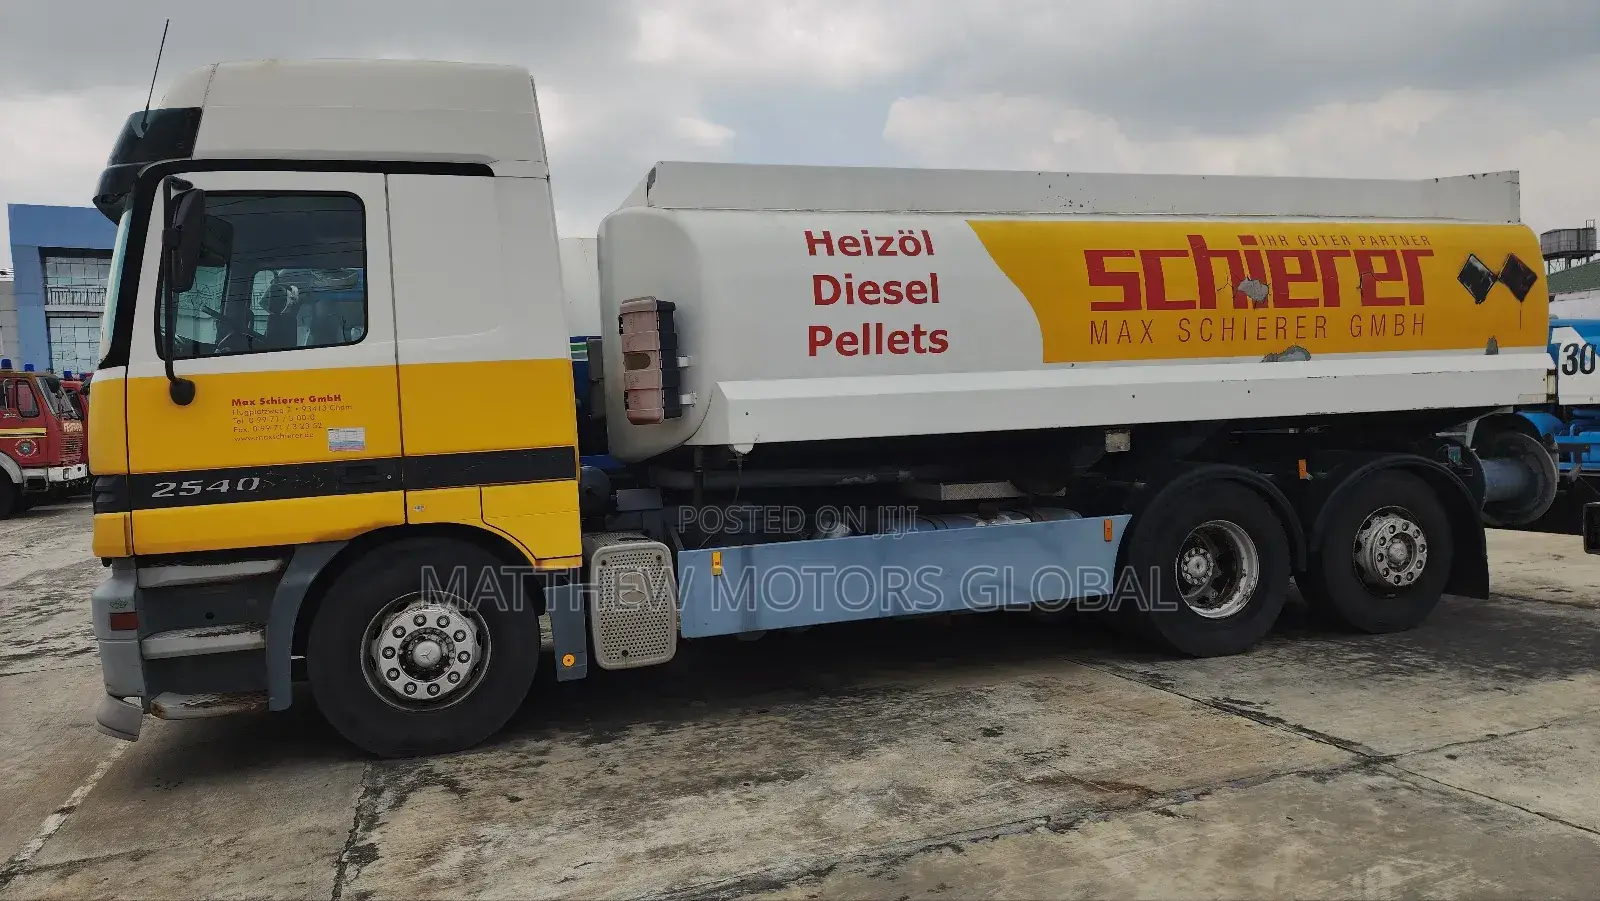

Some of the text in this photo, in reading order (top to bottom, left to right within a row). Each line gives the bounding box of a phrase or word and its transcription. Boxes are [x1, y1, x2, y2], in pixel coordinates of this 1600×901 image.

[804, 229, 935, 257] Heizöl
[1259, 235, 1432, 247] IHR GUTER PARTNER
[812, 272, 940, 306] Diesel
[808, 322, 949, 357] Pellets
[1090, 313, 1425, 345] MAX SCHIERER GMBH
[1561, 342, 1597, 376] 30
[231, 394, 342, 407] Max Schierer GmbH
[151, 477, 260, 498] 2540
